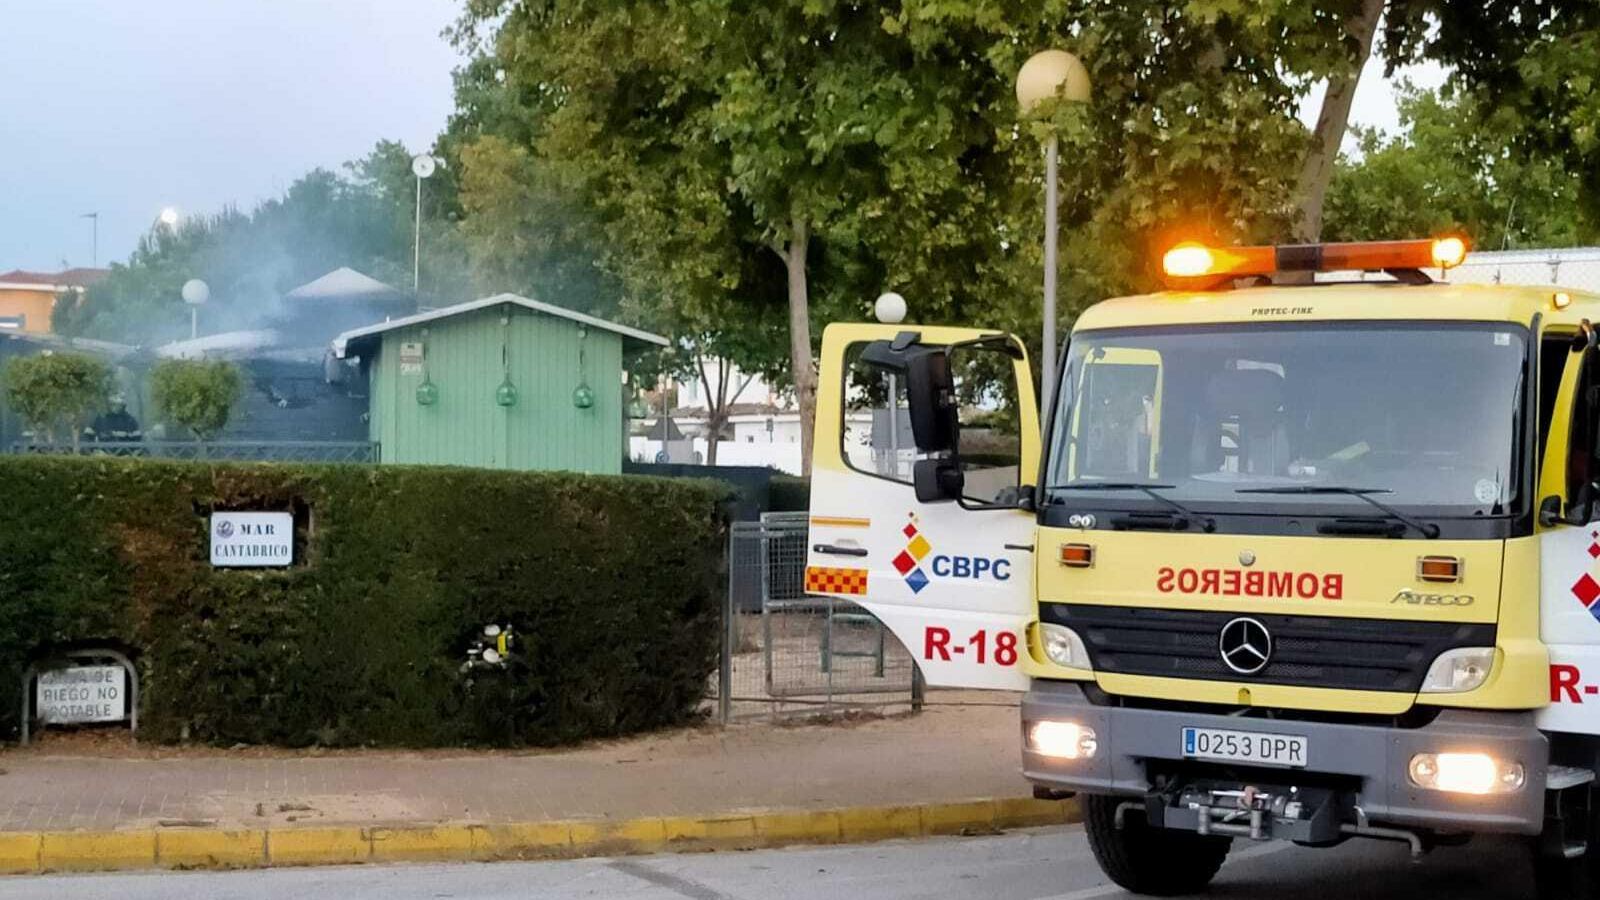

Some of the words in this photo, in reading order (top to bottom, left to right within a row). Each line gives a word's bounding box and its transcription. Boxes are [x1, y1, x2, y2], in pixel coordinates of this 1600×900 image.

[240, 524, 275, 535] MAR
[215, 545, 288, 557] CANTABRICO
[932, 554, 1011, 581] CBPC
[924, 626, 1018, 666] R-18
[44, 688, 89, 701] RIEGO
[97, 686, 118, 700] NO
[1198, 733, 1252, 756] 0253
[1260, 738, 1301, 761] DPR
